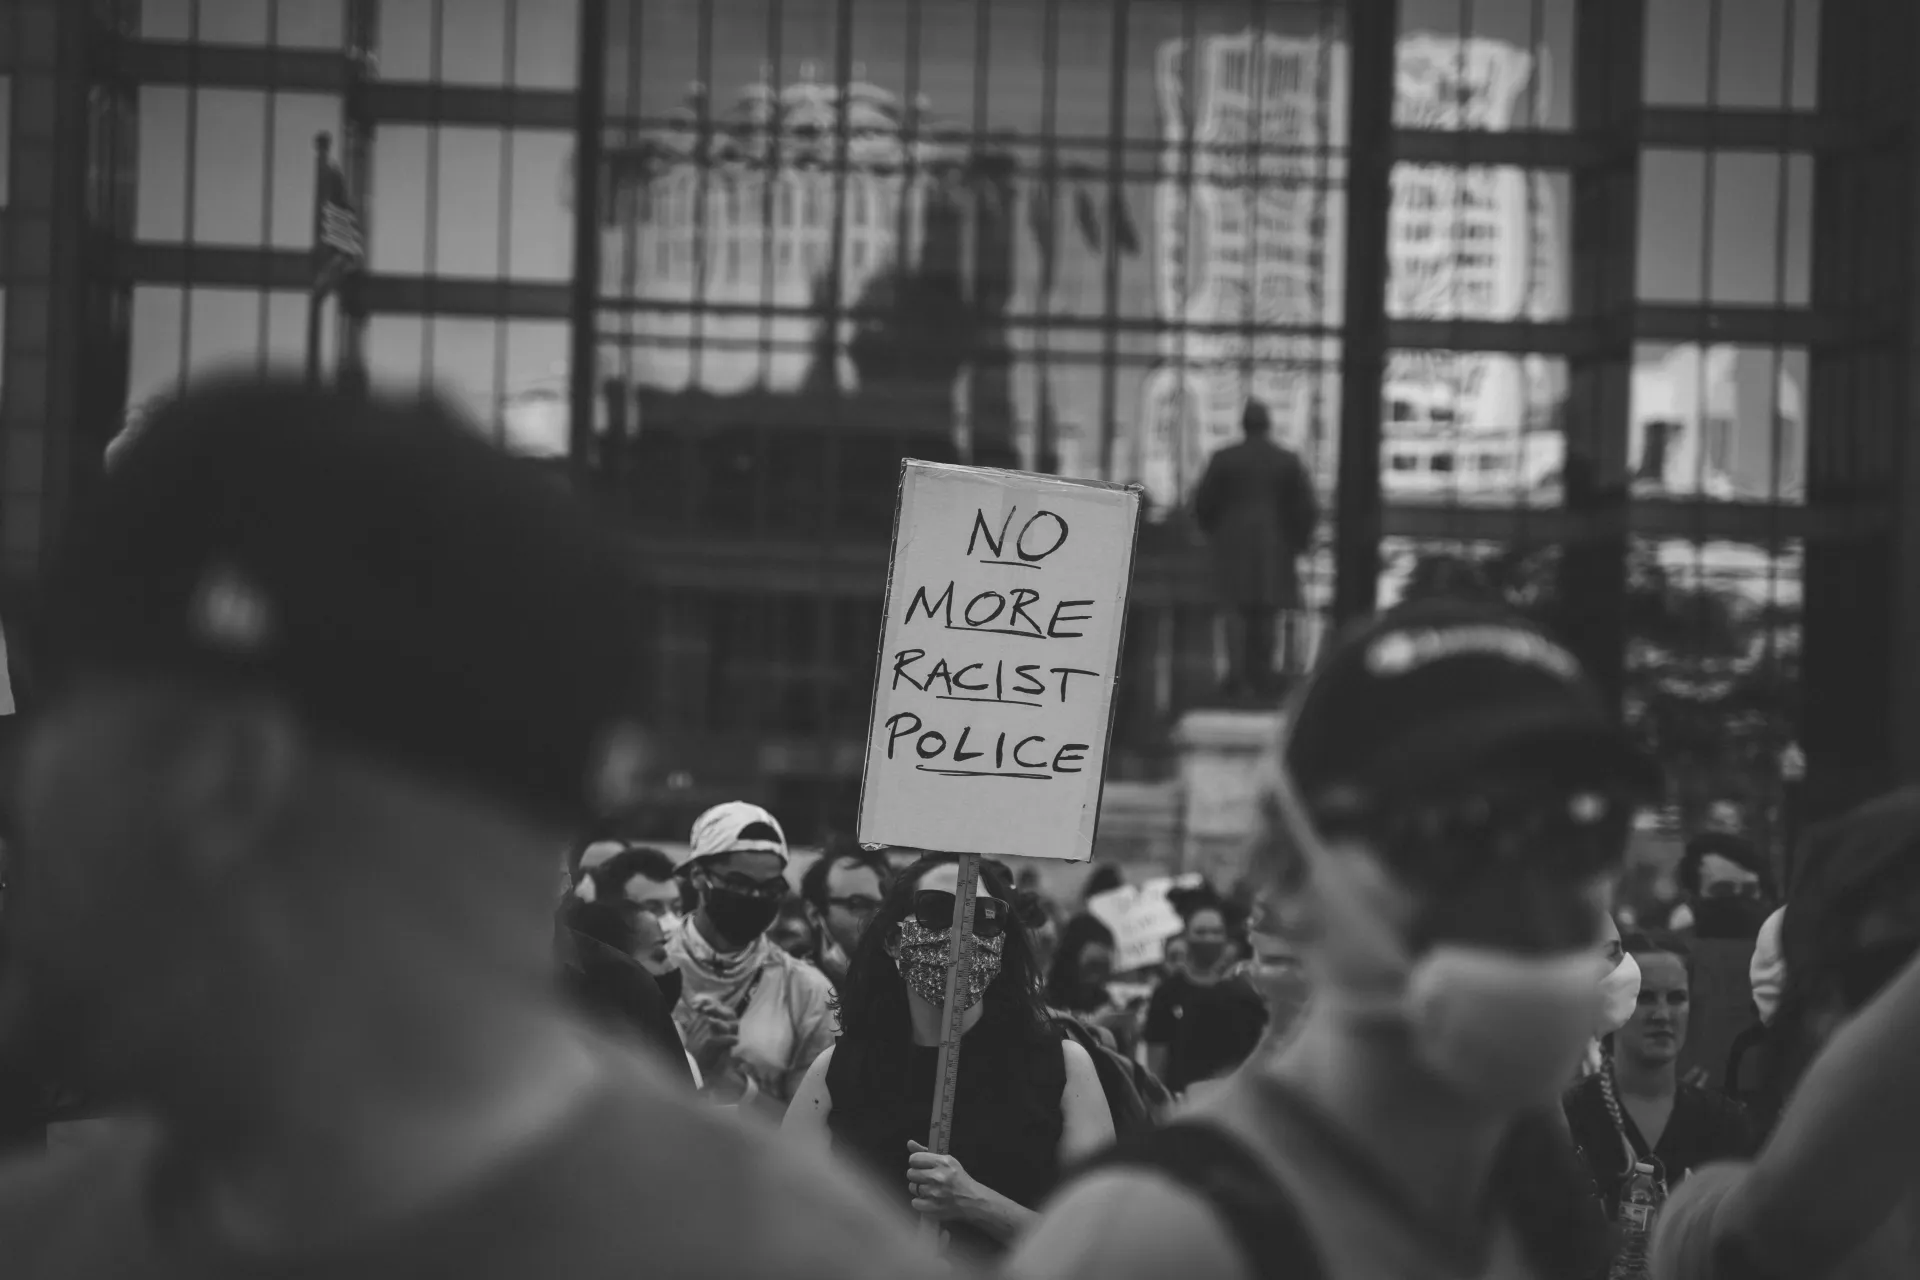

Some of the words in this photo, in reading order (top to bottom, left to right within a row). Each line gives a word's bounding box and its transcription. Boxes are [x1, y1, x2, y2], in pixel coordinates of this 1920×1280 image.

[966, 505, 1069, 562] NO
[904, 580, 1095, 639] MORE
[892, 648, 1100, 703] RACIST
[884, 711, 1090, 773] POLICE
